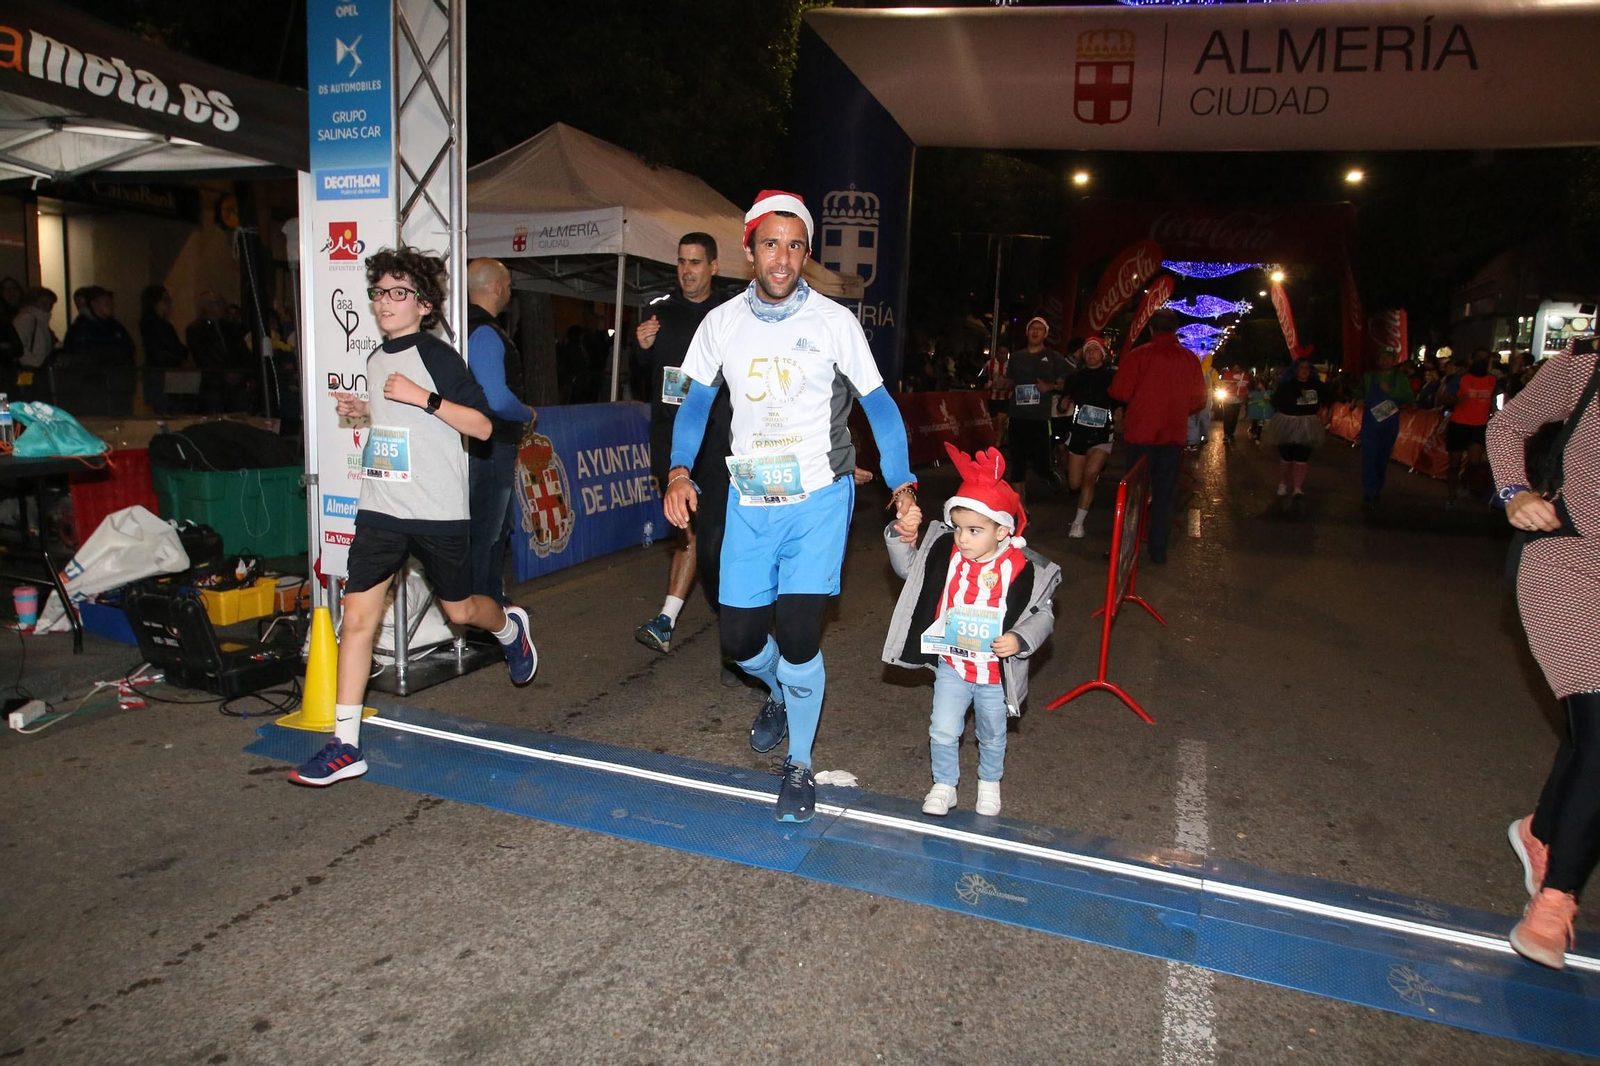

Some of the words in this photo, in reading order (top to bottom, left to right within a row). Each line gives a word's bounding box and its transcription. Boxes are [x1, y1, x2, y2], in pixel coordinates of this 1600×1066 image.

[335, 4, 359, 18] OPEL
[1194, 15, 1479, 75] ALMERÍA
[318, 84, 329, 95] DS
[330, 80, 382, 94] AUTOMOBILES
[1190, 86, 1330, 117] CIUDAD
[332, 109, 367, 124] GRUPO
[317, 127, 359, 141] SALINAS
[360, 125, 381, 138] CAR
[324, 174, 380, 190] DECATHLON
[539, 221, 600, 239] ALMERÍA
[538, 239, 570, 249] CIUDAD
[782, 357, 798, 367] TCS
[373, 441, 399, 458] 385
[761, 468, 793, 485] 395
[581, 486, 607, 516] DE
[325, 533, 336, 543] La
[336, 534, 351, 545] Voz
[957, 620, 990, 639] 396
